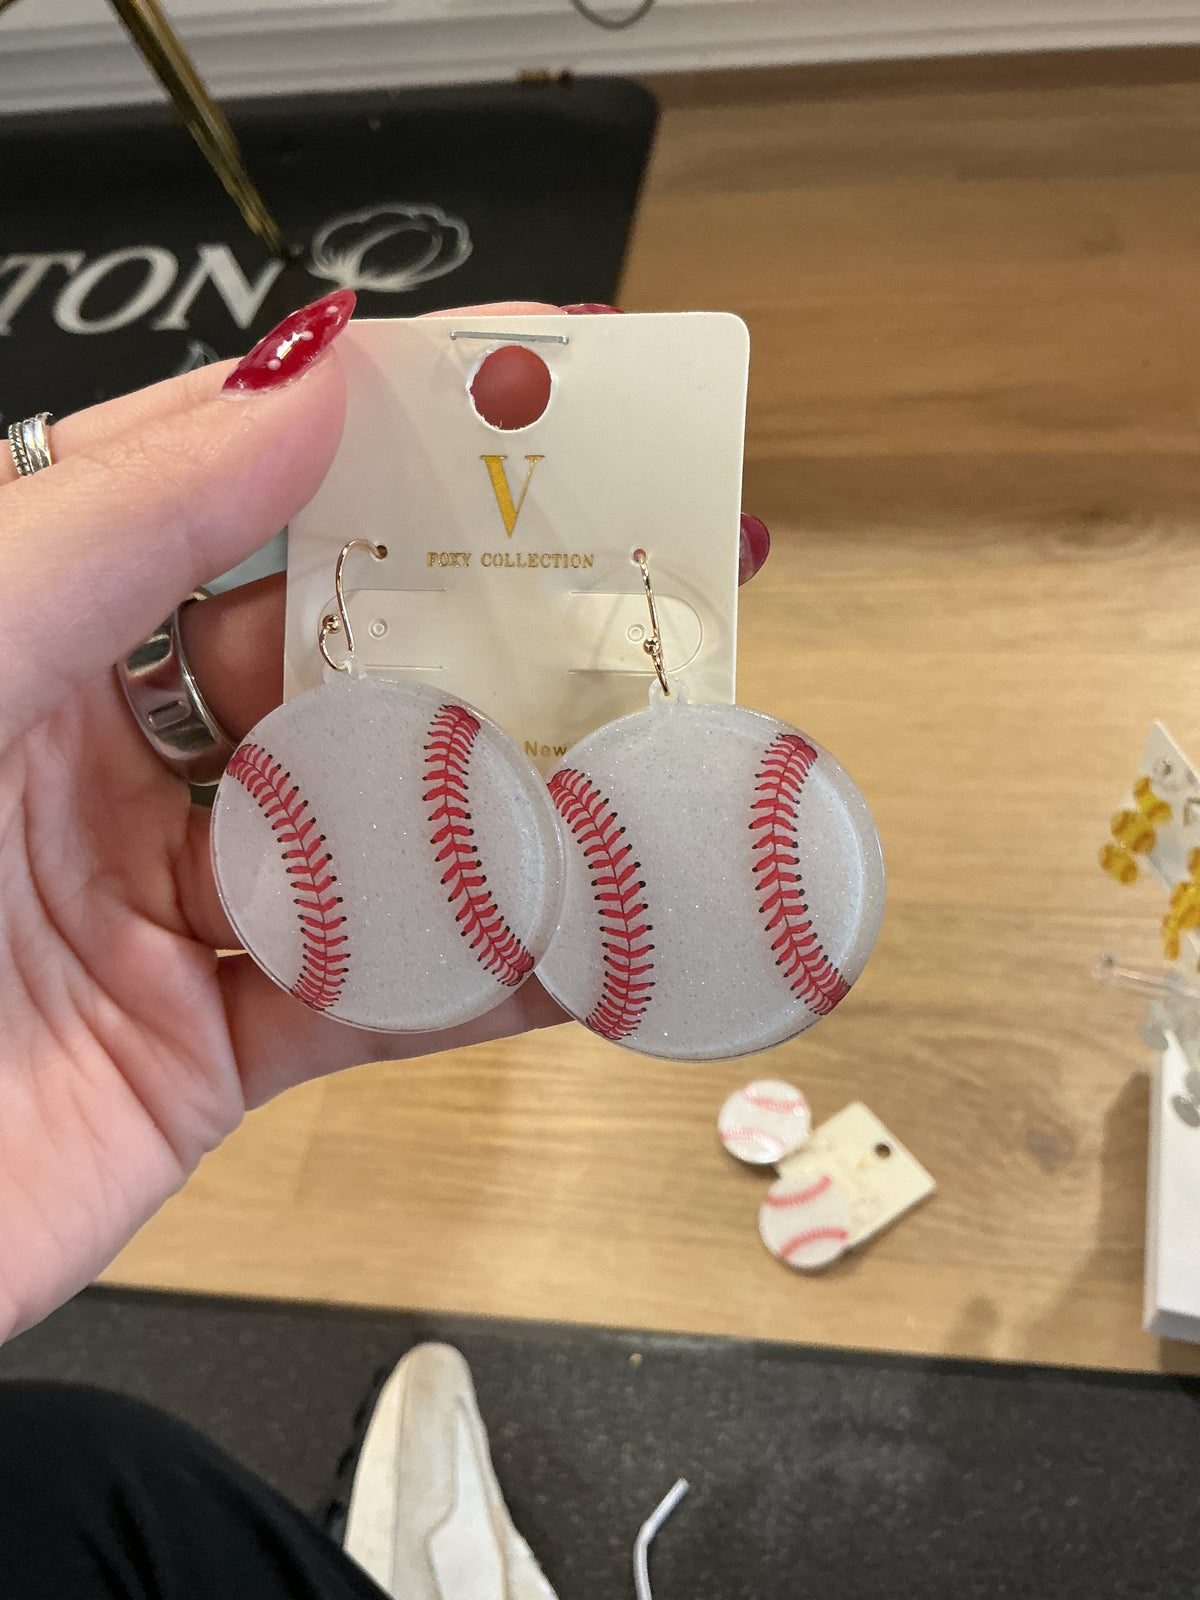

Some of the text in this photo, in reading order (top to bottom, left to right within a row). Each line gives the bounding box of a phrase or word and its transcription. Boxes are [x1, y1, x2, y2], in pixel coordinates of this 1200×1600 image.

[0, 243, 285, 335] TON
[479, 454, 545, 538] V
[426, 552, 594, 568] FOXY COLLECTION
[524, 740, 567, 757] New
